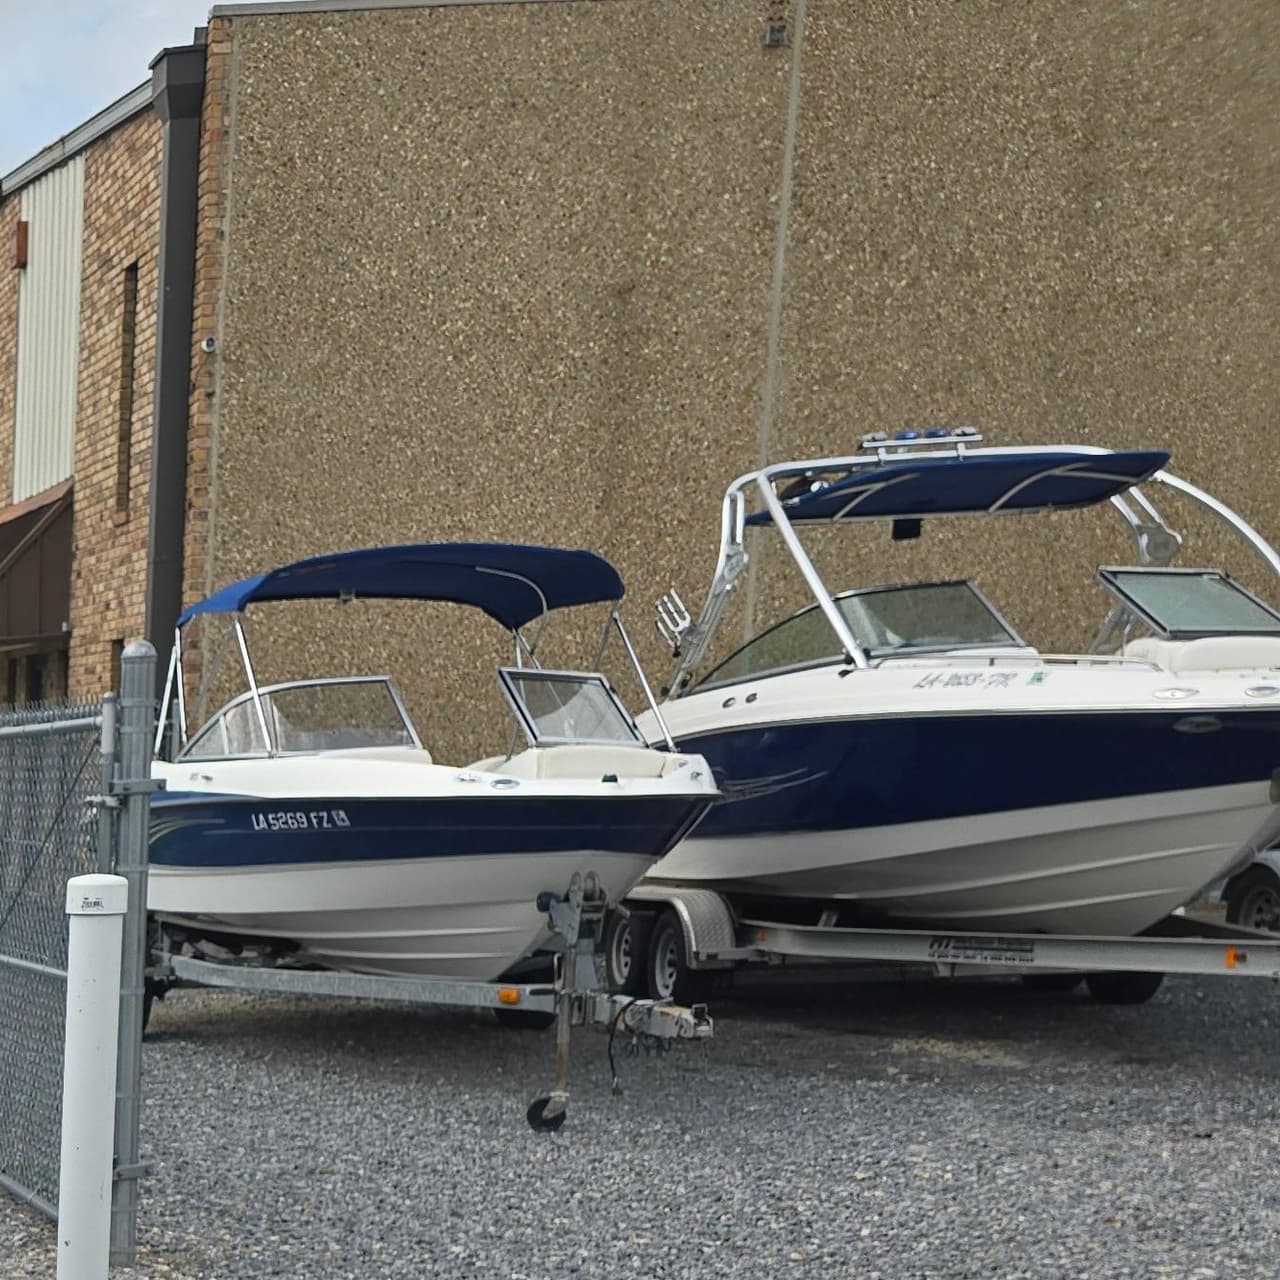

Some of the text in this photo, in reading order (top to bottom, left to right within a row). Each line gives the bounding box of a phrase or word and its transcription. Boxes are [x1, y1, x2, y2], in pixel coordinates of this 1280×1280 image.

[251, 812, 269, 831] LA
[268, 811, 308, 830] 5269
[310, 811, 332, 829] FZ
